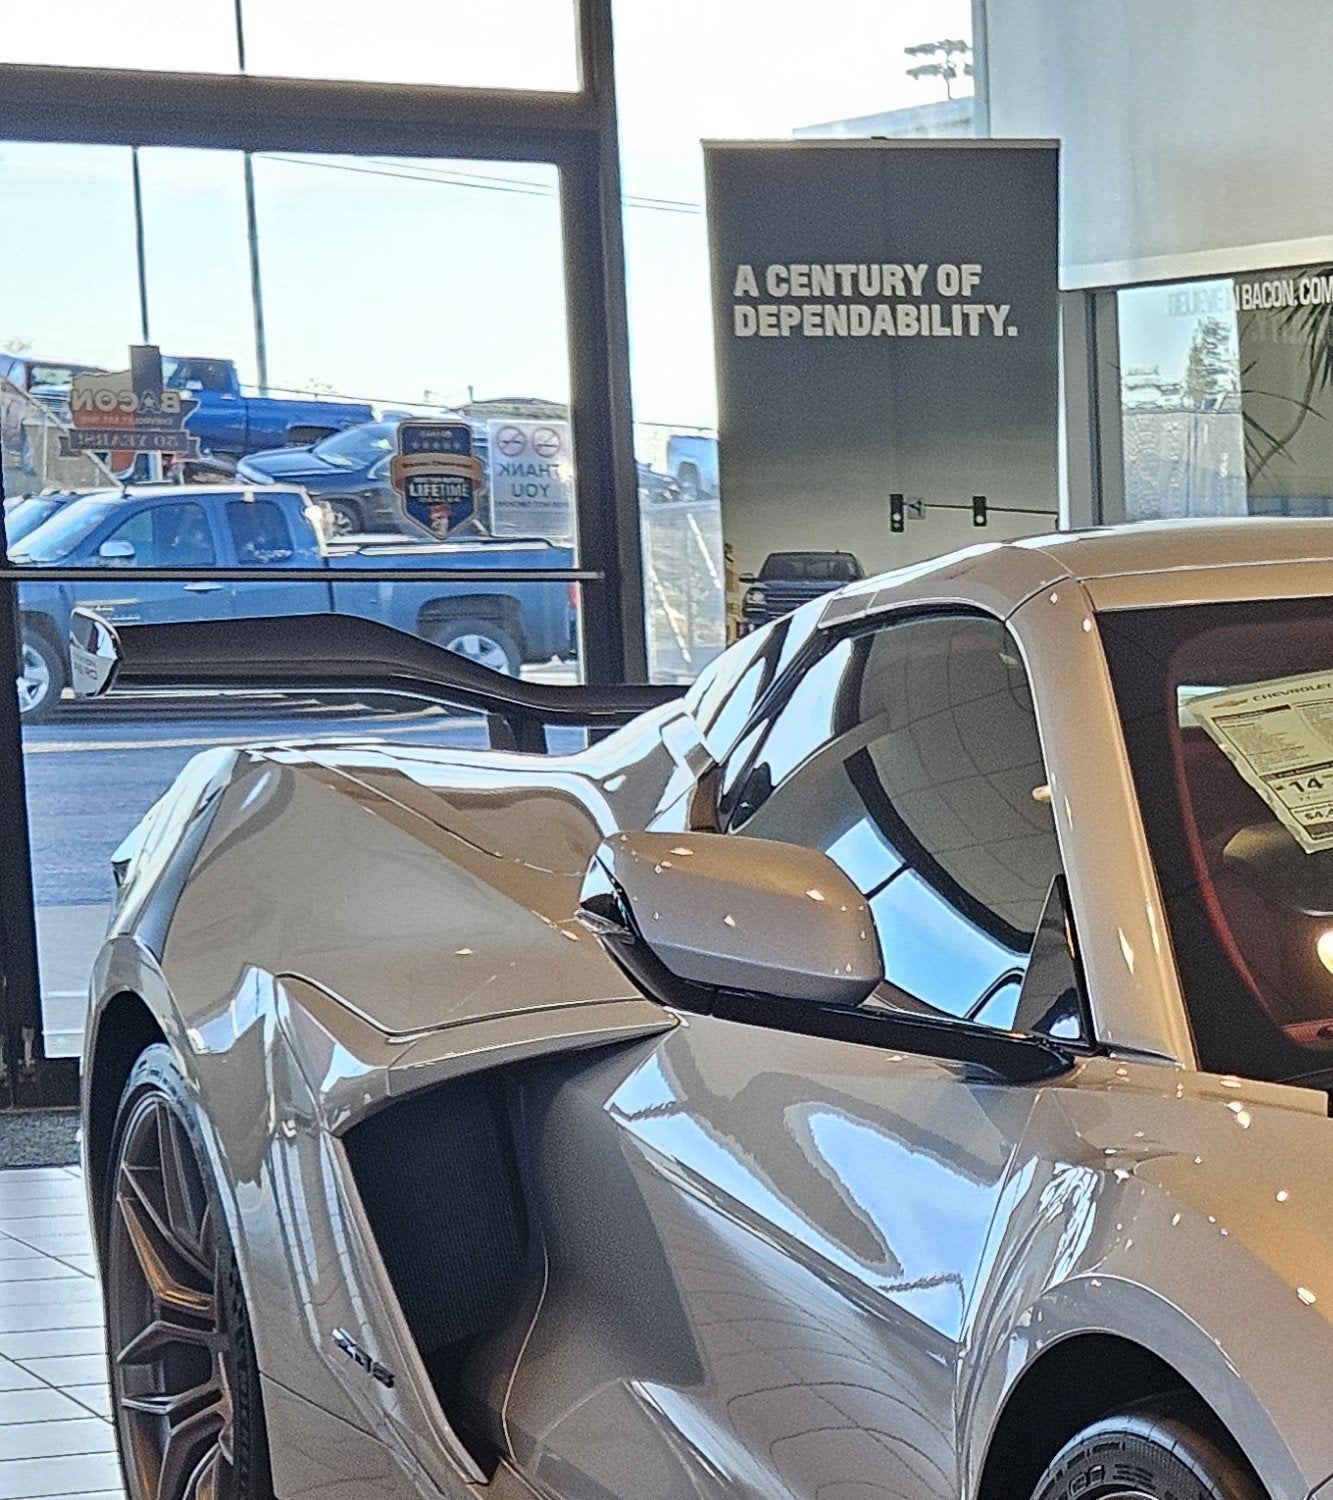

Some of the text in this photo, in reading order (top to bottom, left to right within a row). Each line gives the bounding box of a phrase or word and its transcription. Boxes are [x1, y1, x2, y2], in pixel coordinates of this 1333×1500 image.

[733, 264, 982, 297] A CENTURY OF
[733, 304, 1018, 337] DEPENDABILITY.
[409, 483, 471, 498] LIFETIME
[1252, 682, 1332, 702] CHEVROLET
[1288, 777, 1325, 792] 14
